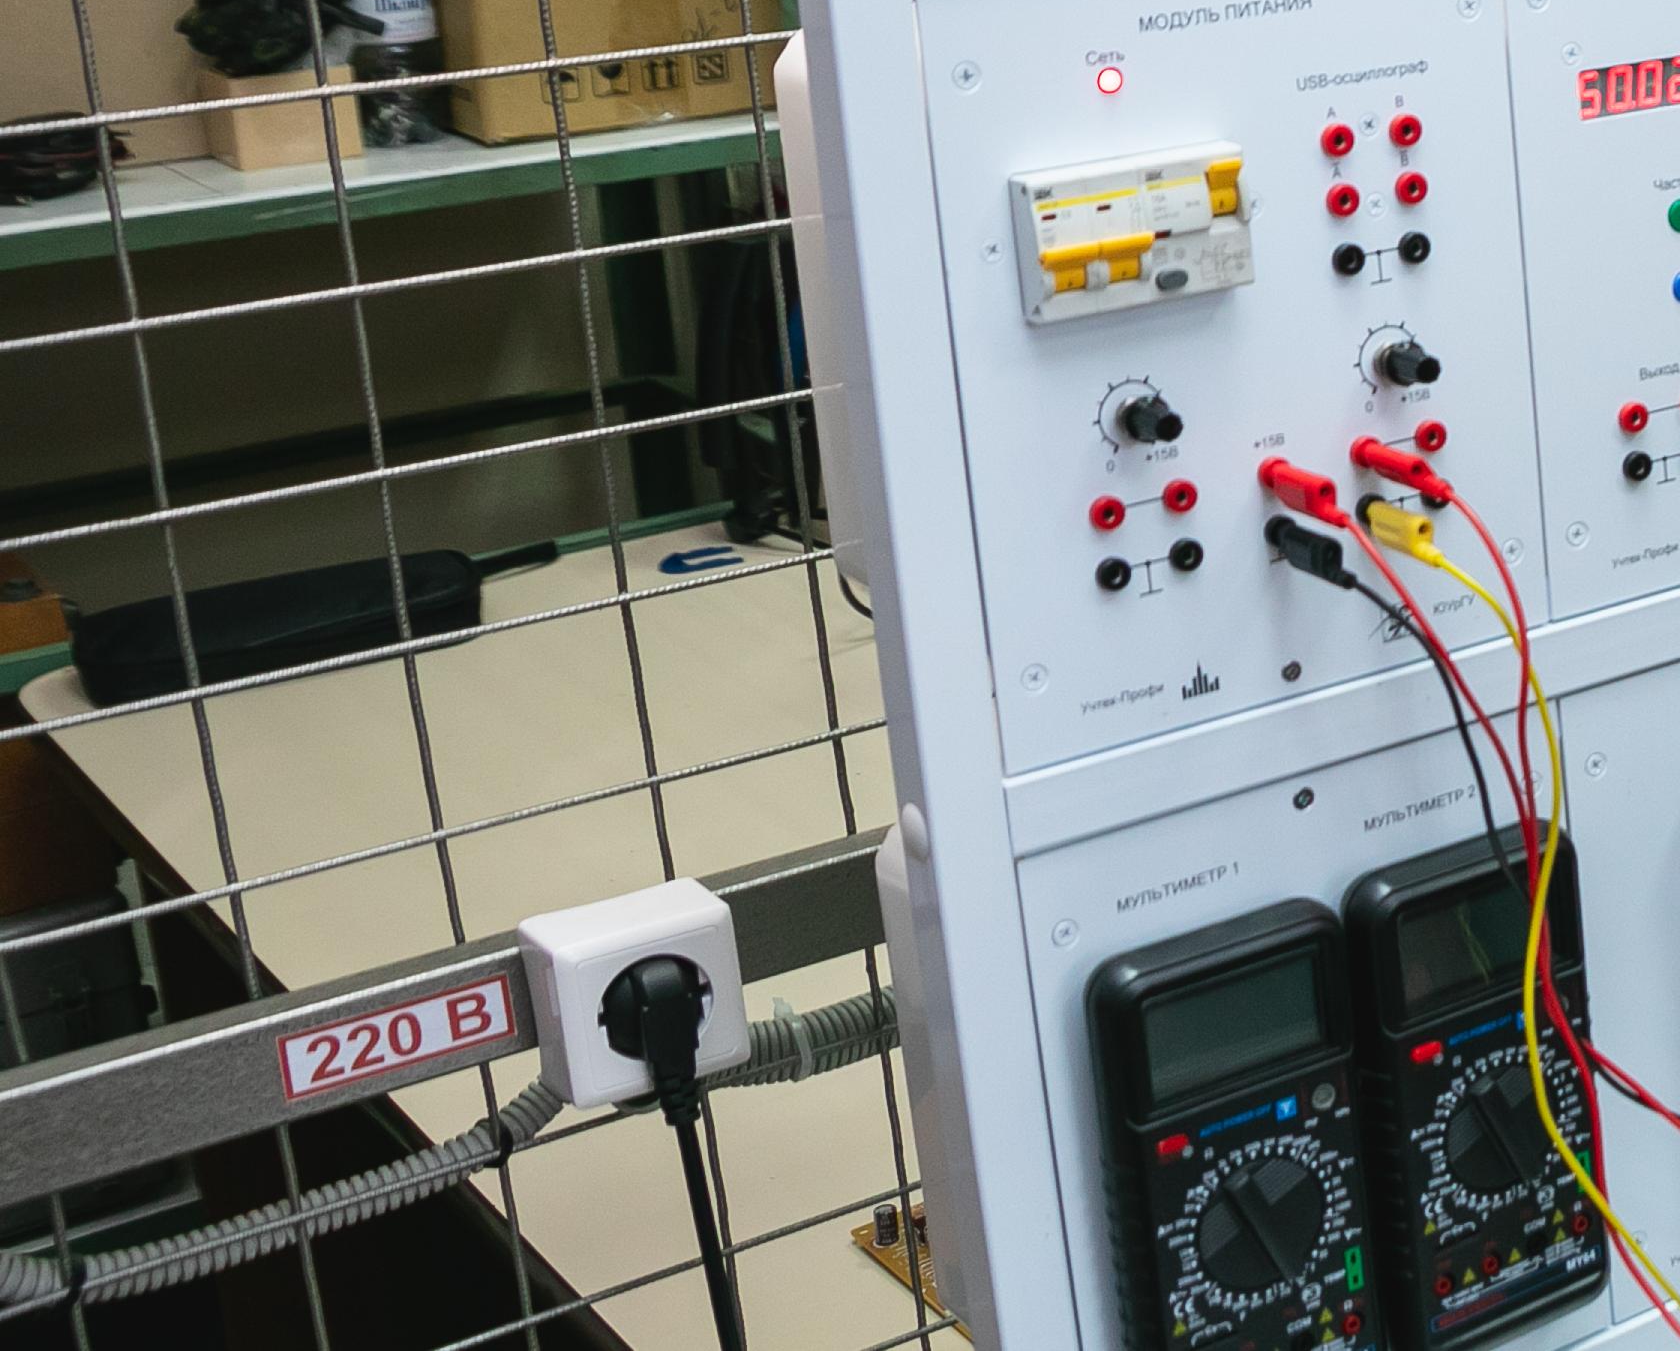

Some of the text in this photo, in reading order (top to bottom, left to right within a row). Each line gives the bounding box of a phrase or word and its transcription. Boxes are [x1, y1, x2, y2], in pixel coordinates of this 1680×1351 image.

[1139, 5, 1220, 34] МОДУЛЬ
[1085, 50, 1126, 67] Сеть
[1296, 59, 1429, 92] USB-осциллограф
[1639, 362, 1680, 381] Выход
[1364, 784, 1476, 832] МУЛЬТИМЕТР 2
[1116, 866, 1228, 914] МУЛЬТИМЕТР
[305, 1015, 423, 1084] 220
